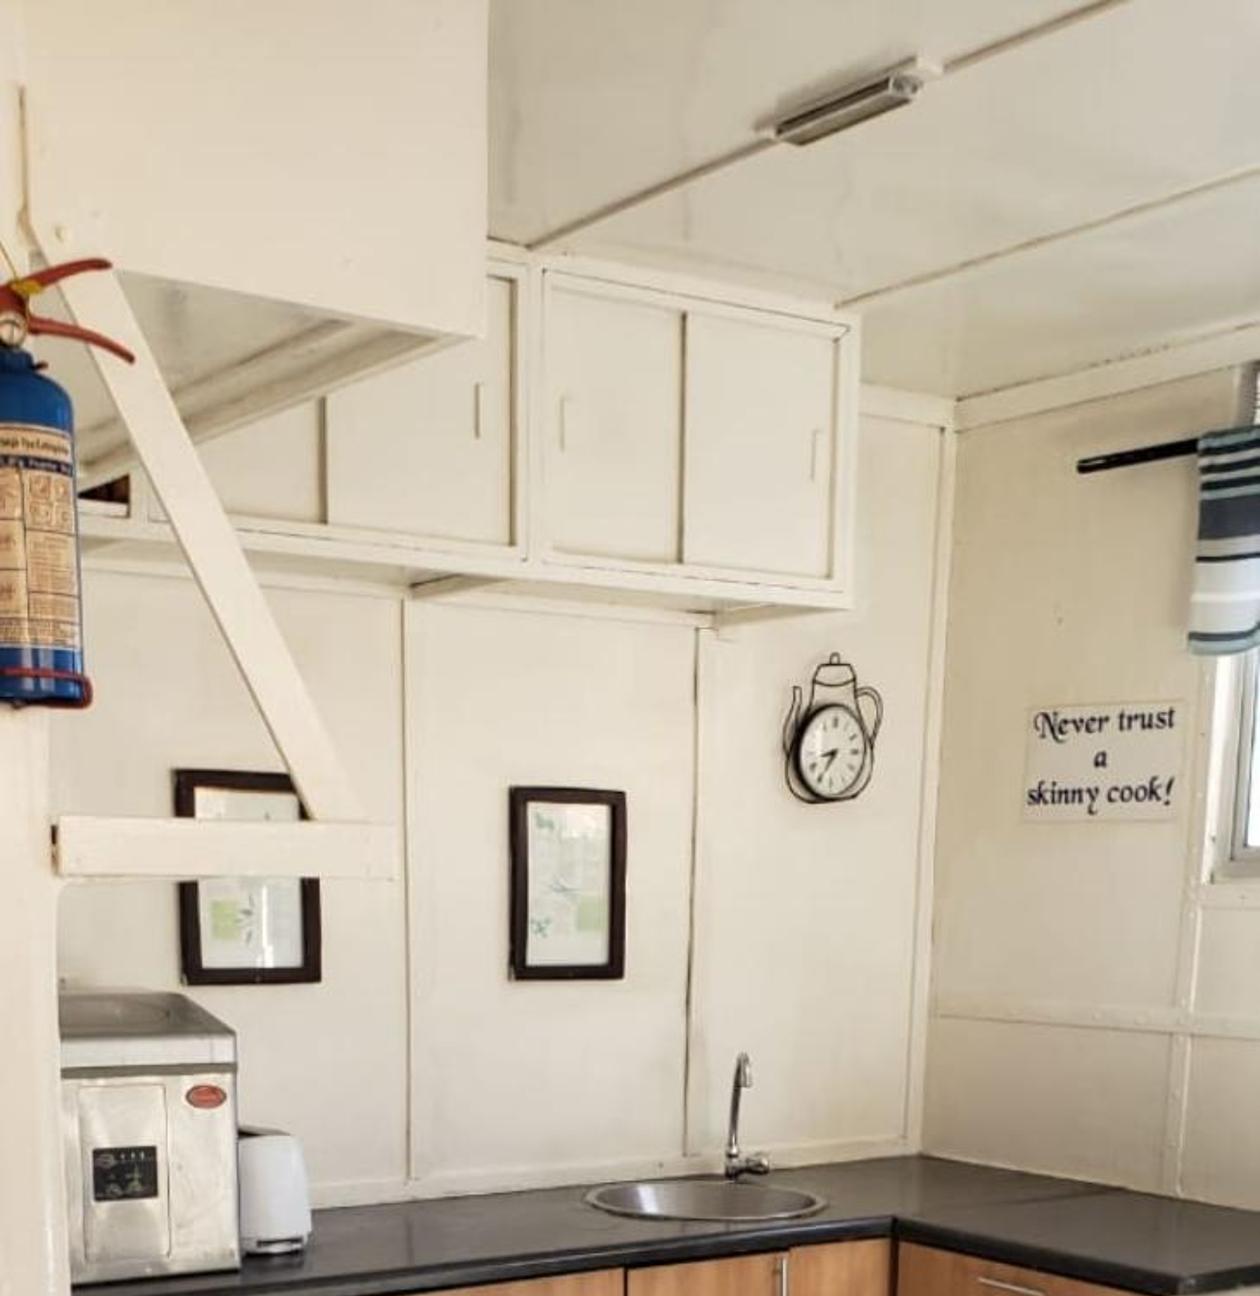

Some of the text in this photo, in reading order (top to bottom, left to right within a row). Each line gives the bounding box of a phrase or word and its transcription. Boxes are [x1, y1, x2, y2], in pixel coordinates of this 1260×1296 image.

[1033, 707, 1175, 744] Never trust
[1093, 750, 1108, 768] a
[1026, 775, 1175, 816] skinny cook!
